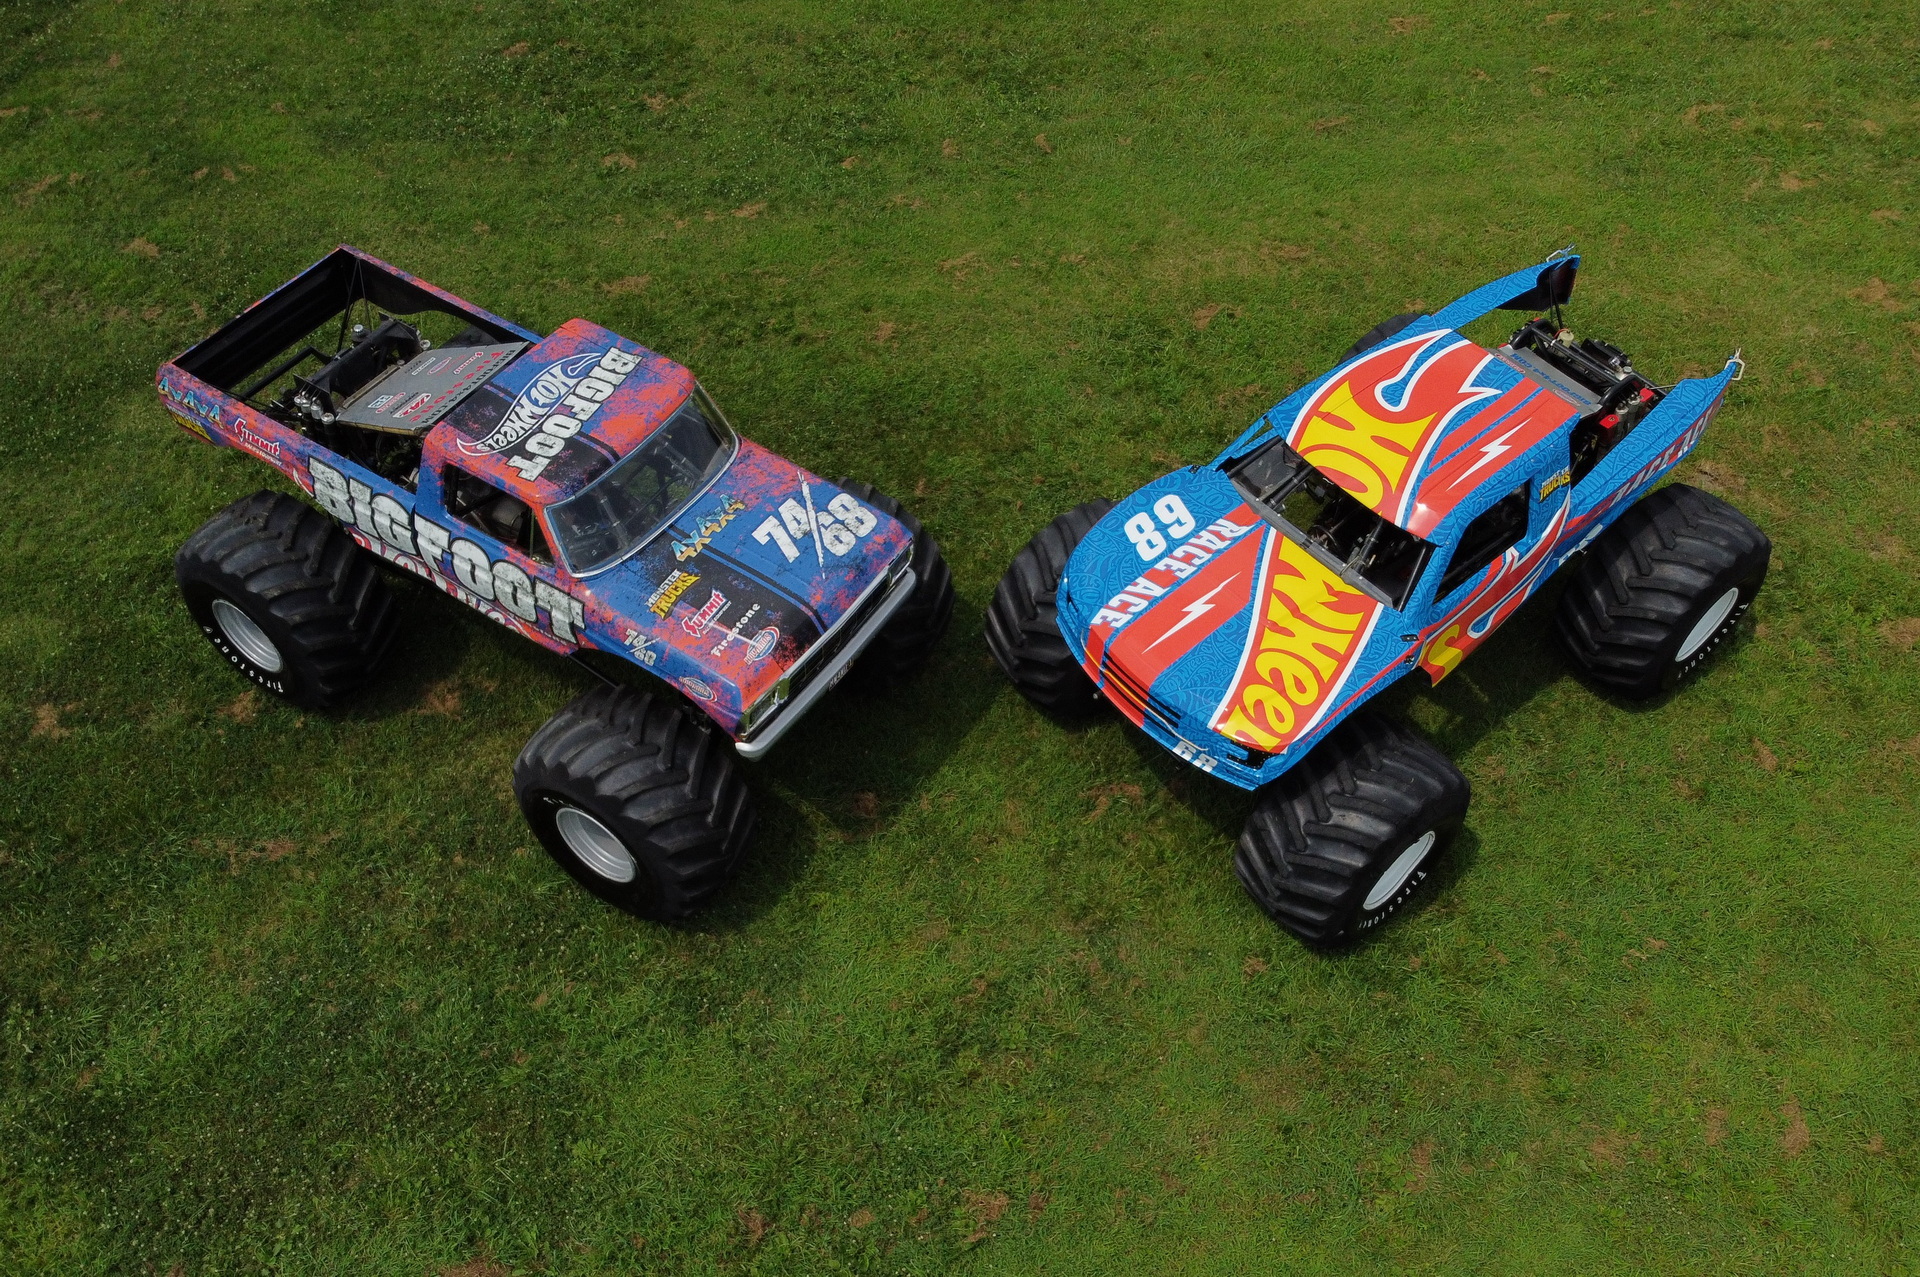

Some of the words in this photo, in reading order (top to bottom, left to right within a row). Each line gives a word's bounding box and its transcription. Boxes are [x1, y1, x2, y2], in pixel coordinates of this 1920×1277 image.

[530, 364, 587, 410] HOT
[506, 346, 644, 482] BIGFOOT
[1296, 380, 1439, 515] HO
[1539, 471, 1571, 502] TRUCKS
[308, 455, 586, 645] BIGFOOT
[751, 469, 878, 579] 74/68
[1124, 494, 1196, 562] 68
[1153, 518, 1257, 579] RACE
[644, 568, 682, 608] MONSTER
[649, 570, 701, 619] TRUCKS
[1090, 576, 1172, 628] ACE
[623, 628, 661, 667] 74/68
[711, 603, 761, 657] Firestone
[1172, 740, 1219, 773] 68
